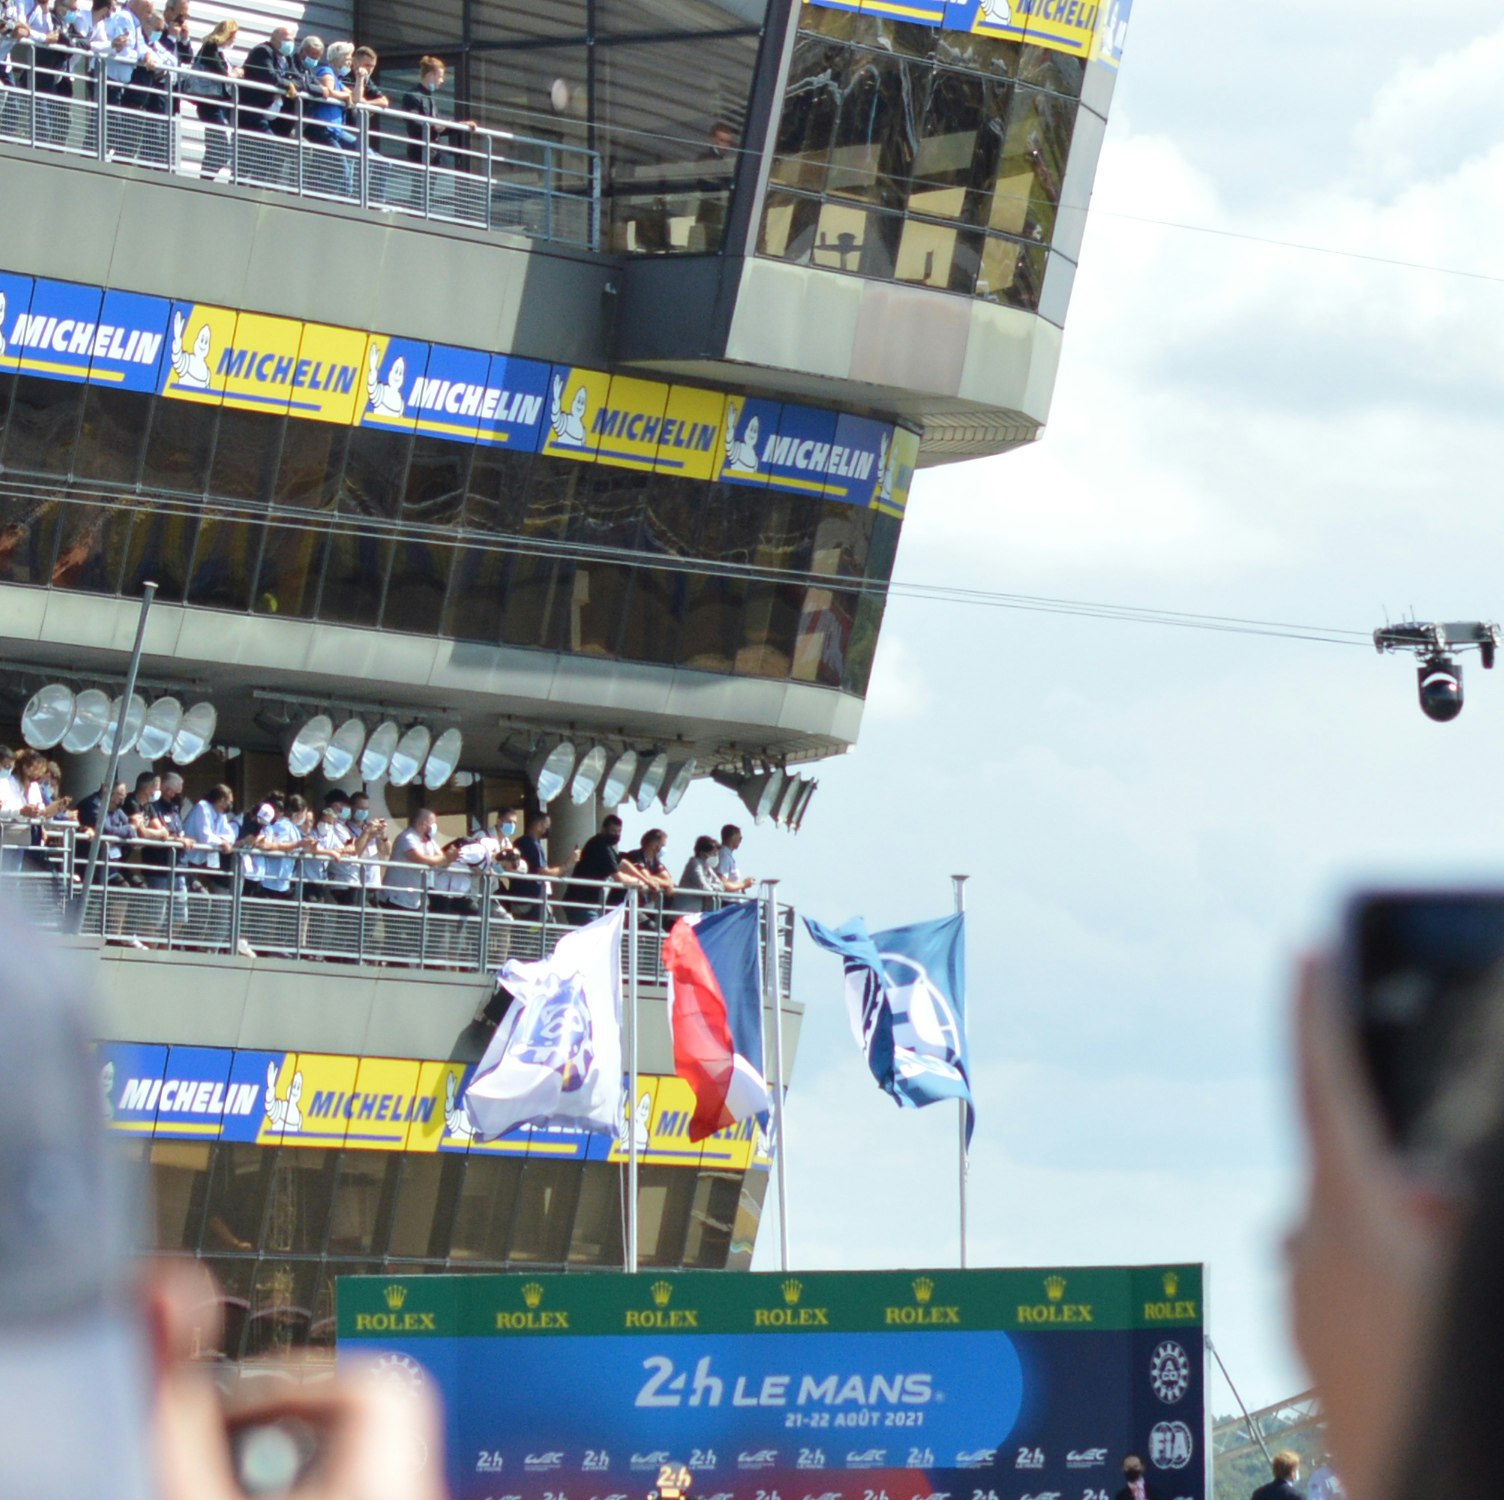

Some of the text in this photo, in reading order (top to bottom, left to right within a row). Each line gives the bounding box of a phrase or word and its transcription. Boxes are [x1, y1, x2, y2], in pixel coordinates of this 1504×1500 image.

[9, 312, 163, 366] MICHELIN
[215, 347, 358, 395] MICHELIN
[407, 376, 543, 426] MICHELIN
[590, 407, 717, 453] MICHELIN
[760, 434, 875, 481] MICHELIN
[118, 1078, 260, 1115] MICHELIN
[307, 1090, 437, 1124] MICHELIN
[355, 1313, 436, 1330] ROLEX
[496, 1311, 569, 1328] ROLEX
[624, 1310, 699, 1327] ROLEX
[754, 1308, 829, 1325] ROLEX
[885, 1306, 961, 1323] ROLEX
[1016, 1304, 1093, 1322] ROLEX
[1145, 1301, 1196, 1319] ROLEX
[732, 1375, 791, 1407] LE
[796, 1373, 933, 1405] MANS
[784, 1408, 924, 1428] 21-22 AOÛT 2021
